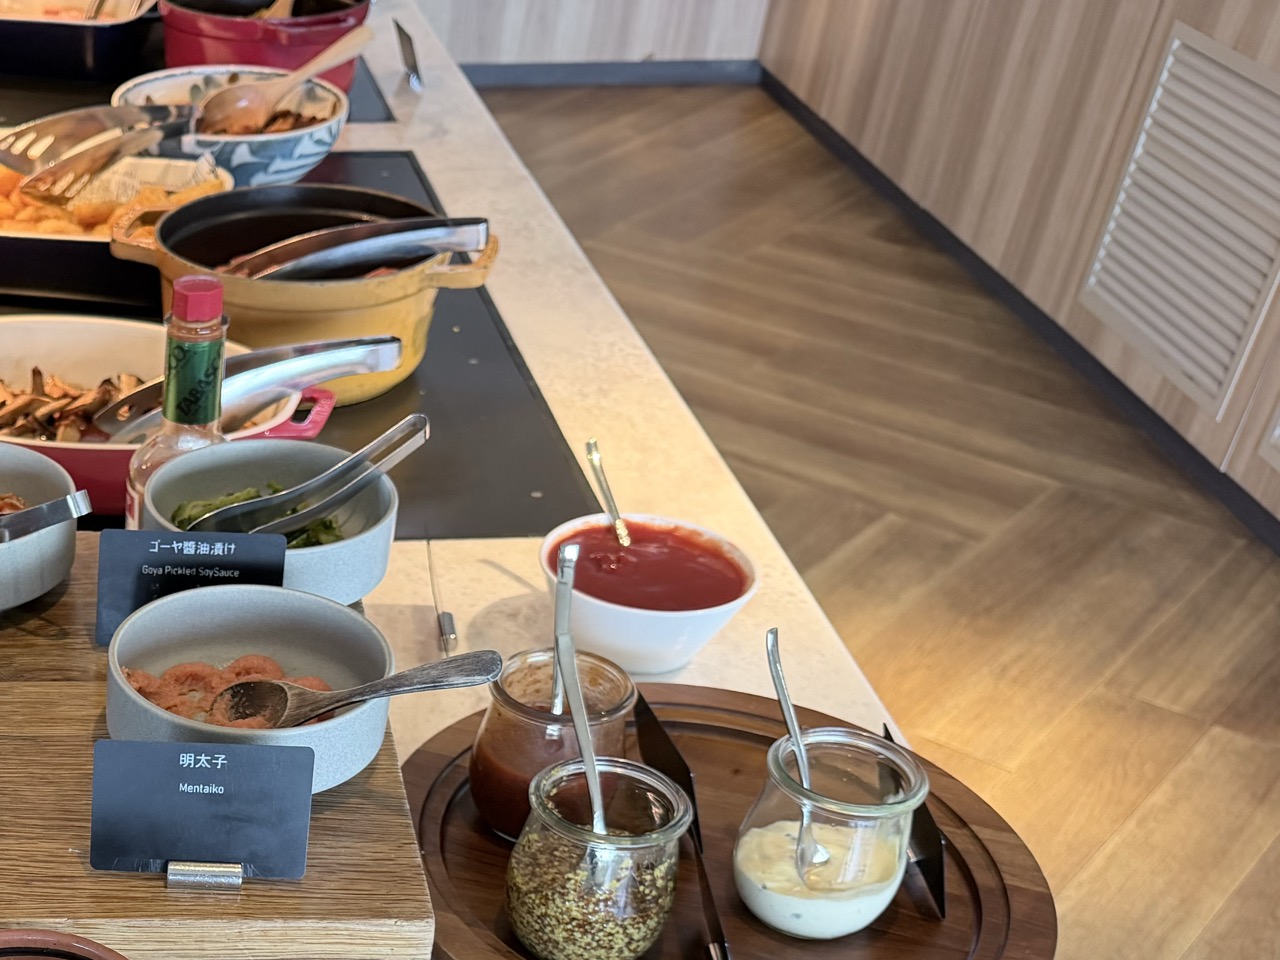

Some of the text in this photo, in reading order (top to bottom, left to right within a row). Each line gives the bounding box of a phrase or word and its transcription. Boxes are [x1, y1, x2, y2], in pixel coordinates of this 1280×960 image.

[177, 350, 223, 417] TABASC
[142, 565, 163, 576] Goya
[165, 566, 196, 575] Pickled
[180, 754, 227, 768] 明太子
[180, 783, 224, 793] Mentaiko
